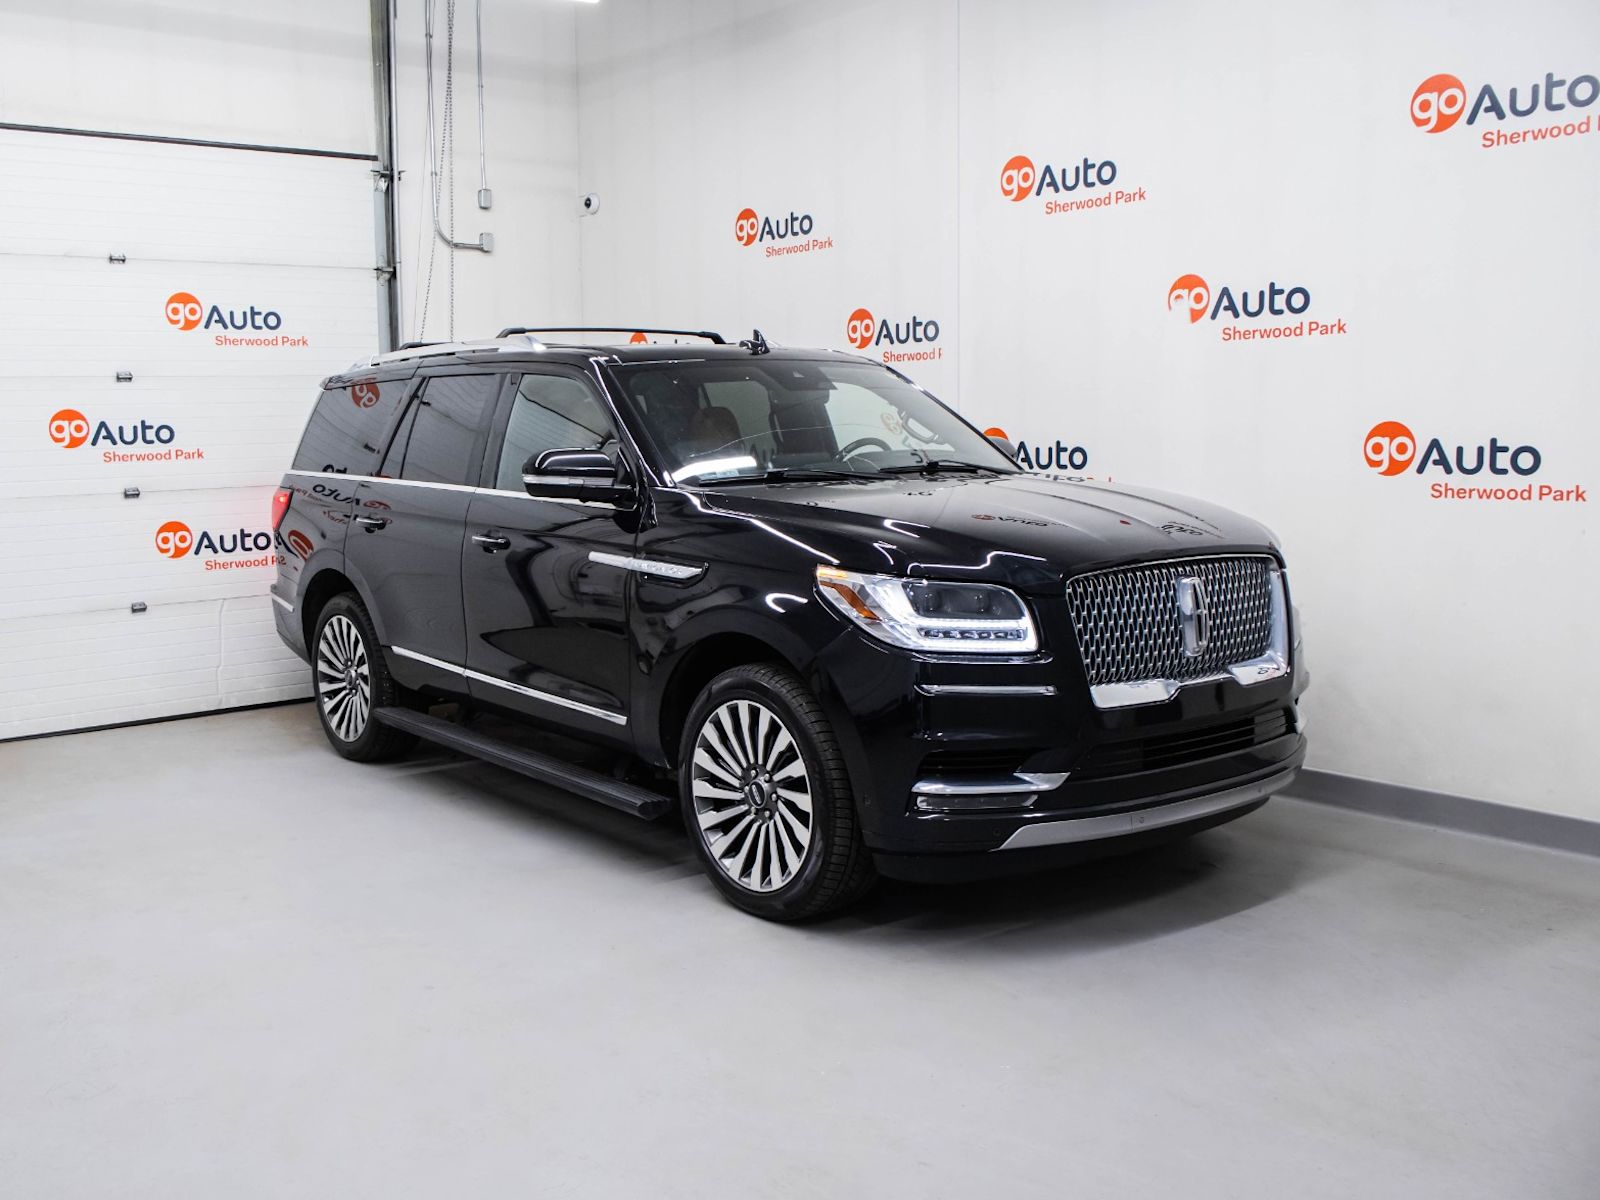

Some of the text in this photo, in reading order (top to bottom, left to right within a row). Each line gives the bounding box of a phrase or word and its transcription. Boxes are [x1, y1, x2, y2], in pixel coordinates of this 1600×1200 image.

[1412, 72, 1600, 131] go Auto
[1482, 115, 1591, 148] Sherwood
[1001, 157, 1117, 200] go Auto
[1045, 187, 1146, 215] Sherwood Park
[736, 211, 813, 245] go Auto
[765, 237, 834, 257] Sherwood Park
[1210, 282, 1311, 320] Auto
[166, 302, 282, 331] go Auto
[1222, 318, 1347, 341] Sherwood Park
[215, 335, 309, 347] Sherwood Park
[848, 315, 940, 348] go Auto
[882, 348, 936, 363] Sherwood
[50, 419, 175, 447] go Auto
[103, 448, 204, 463] Sherwood Park
[1016, 440, 1088, 470] Auto
[1365, 435, 1542, 476] go Auto
[1430, 482, 1587, 502] Sherwood Park
[157, 528, 271, 558] go Auto
[204, 555, 268, 570] Sherwood
